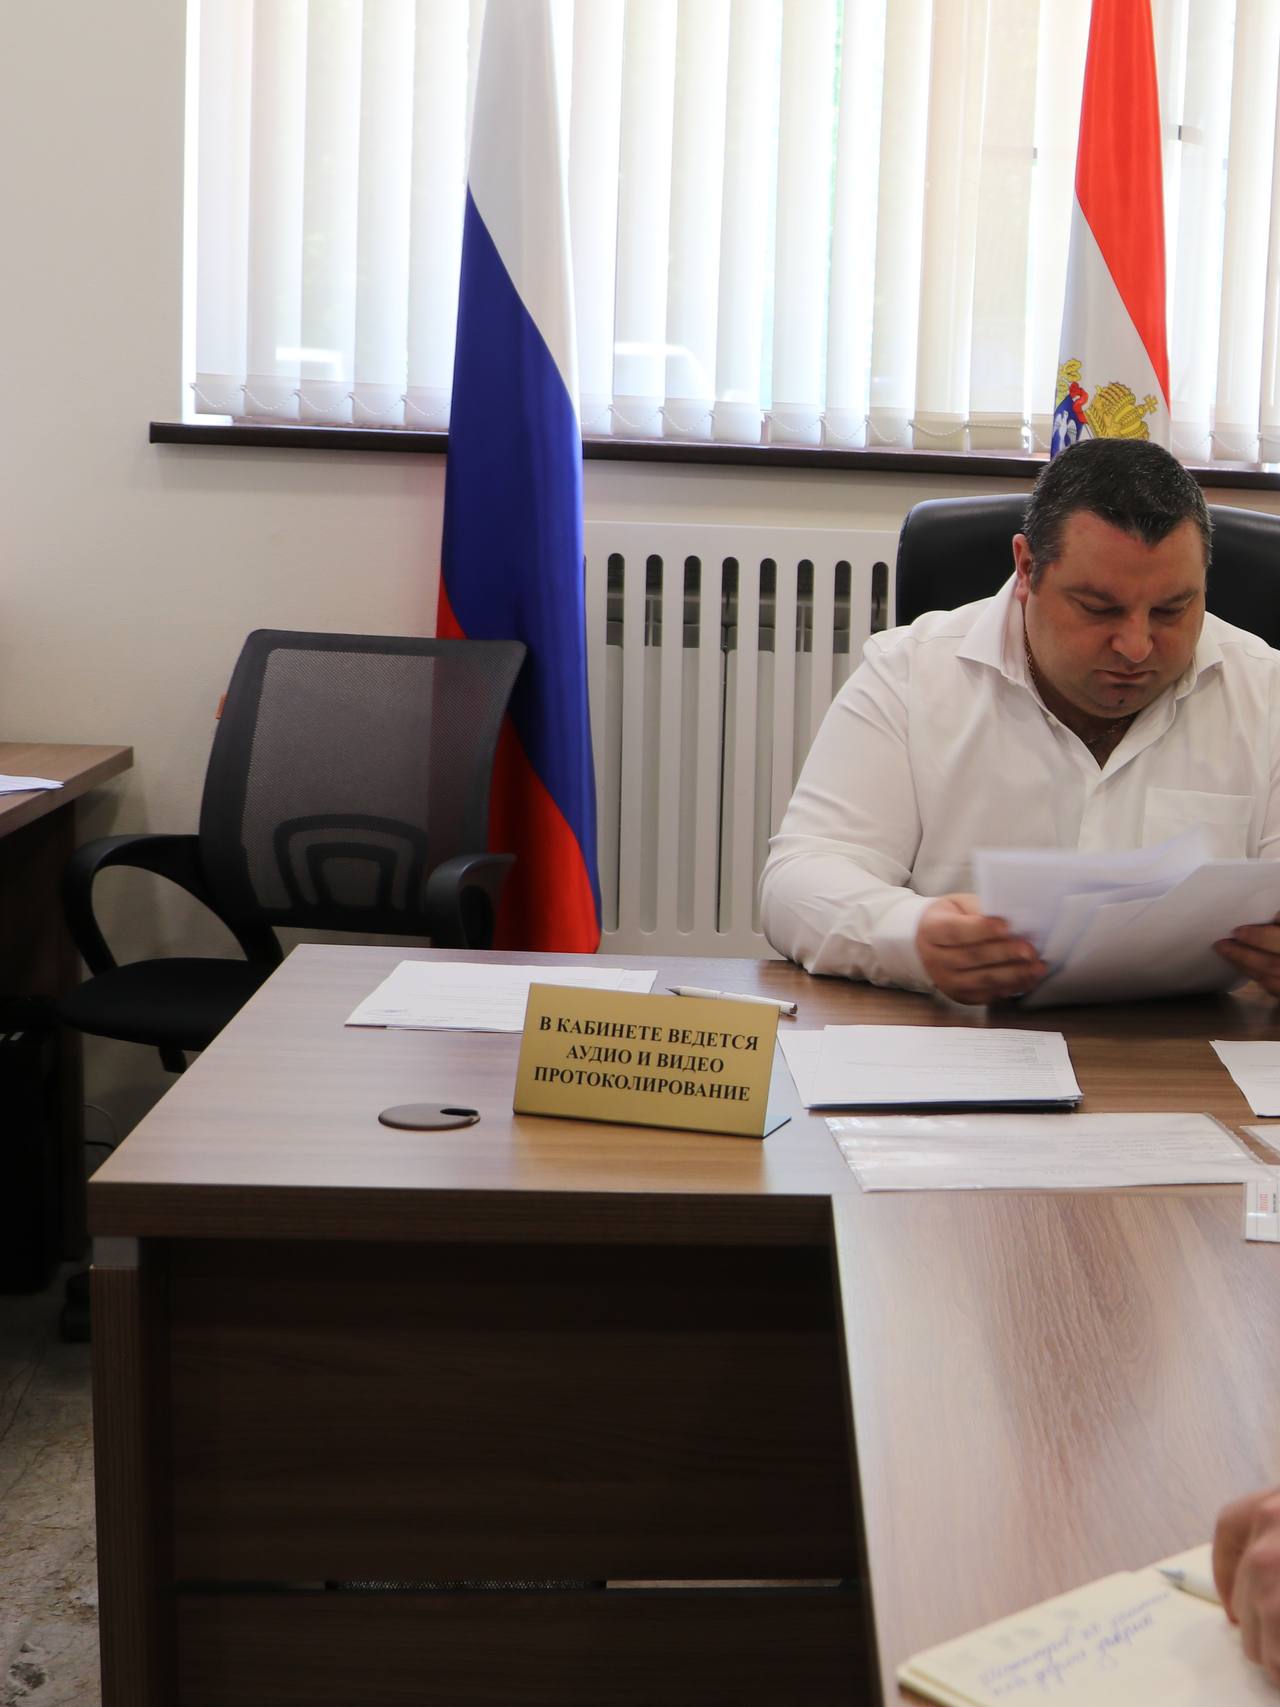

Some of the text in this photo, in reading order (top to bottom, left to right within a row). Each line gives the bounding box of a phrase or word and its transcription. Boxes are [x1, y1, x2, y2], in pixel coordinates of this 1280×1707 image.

[540, 1016, 759, 1051] В КАБИНЕТЕ ВЕДЕТСЯ
[566, 1044, 724, 1073] АУДИО И ВИДЕО
[534, 1066, 751, 1101] ПРОТОКОЛИРОВАНИЕ
